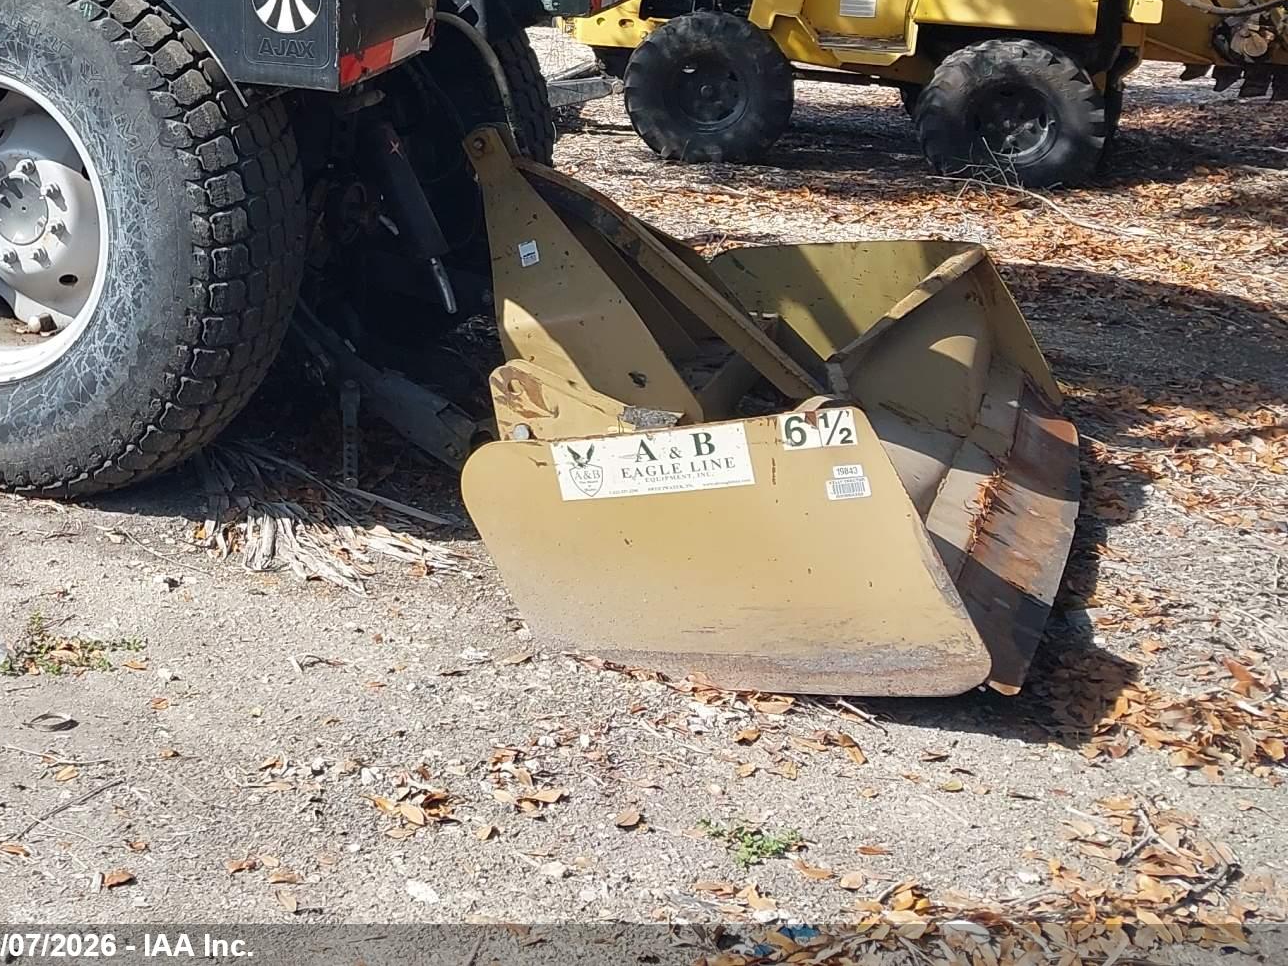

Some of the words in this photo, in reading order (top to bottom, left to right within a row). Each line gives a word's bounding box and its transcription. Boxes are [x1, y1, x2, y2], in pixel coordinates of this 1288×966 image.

[258, 37, 316, 59] AJAX
[785, 415, 807, 447] 6
[635, 438, 658, 463] A
[669, 446, 683, 460] &
[689, 432, 716, 457] B
[575, 469, 601, 480] A&B
[621, 462, 687, 479] EAGLE
[691, 456, 736, 473] LINE
